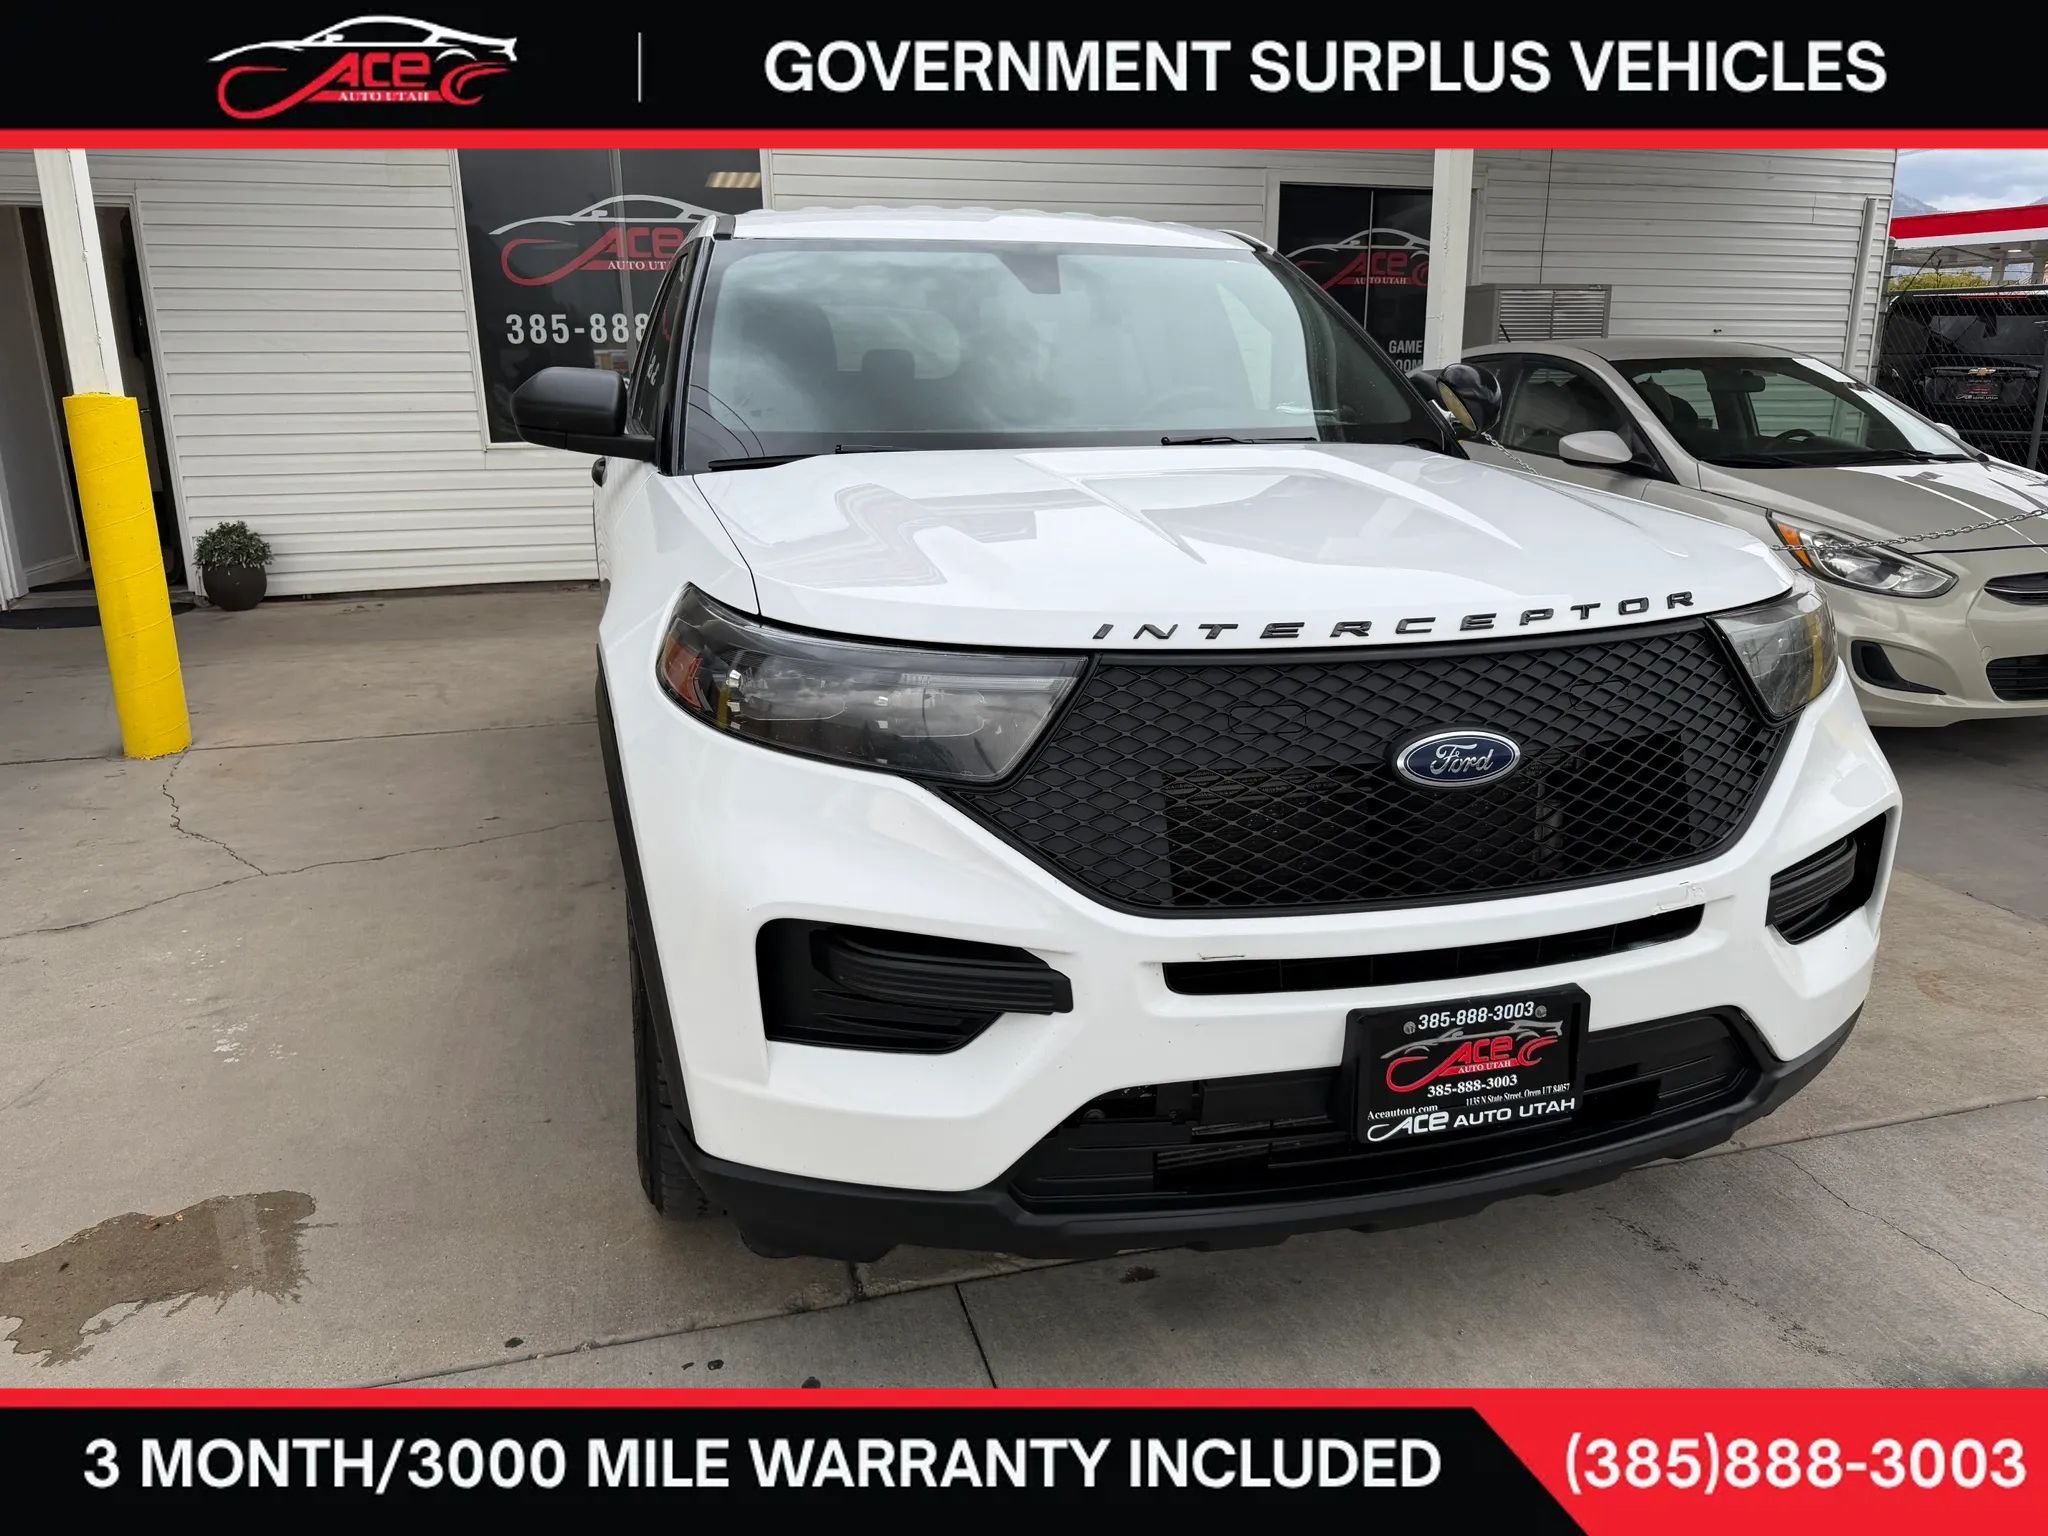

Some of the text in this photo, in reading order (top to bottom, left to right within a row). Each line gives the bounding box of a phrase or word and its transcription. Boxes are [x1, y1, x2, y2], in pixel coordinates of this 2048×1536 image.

[608, 261, 645, 270] AUTO
[1354, 277, 1406, 285] AUTO UTAH
[1389, 340, 1423, 354] GAME
[1092, 590, 1695, 641] INTERCEPTOR
[1429, 743, 1495, 775] Ford
[1418, 1001, 1535, 1030] 385-888-3003
[1458, 1060, 1511, 1074] AUTO UTAH
[1427, 1074, 1518, 1098] 385-888-3003
[1481, 1095, 1487, 1104] N
[1542, 1086, 1553, 1095] UT
[1367, 1104, 1438, 1120] Aceautout.com
[1453, 1108, 1512, 1128] AUTO
[1520, 1098, 1575, 1118] UTAH
